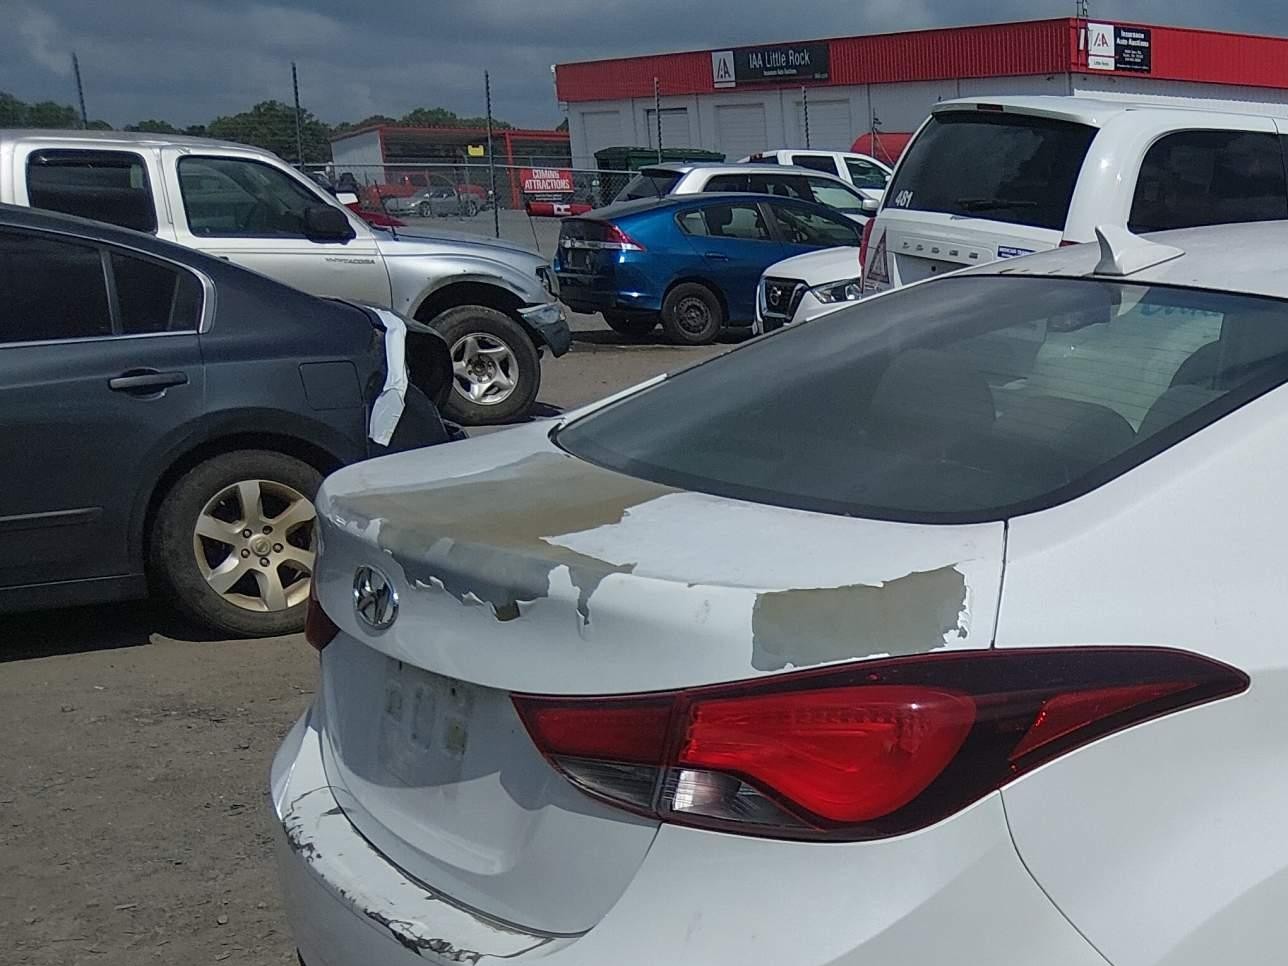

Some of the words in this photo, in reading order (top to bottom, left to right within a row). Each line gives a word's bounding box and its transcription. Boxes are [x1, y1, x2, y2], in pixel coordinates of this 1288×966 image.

[749, 52, 763, 69] IAA
[765, 51, 786, 68] Little
[788, 48, 811, 66] Rock
[532, 169, 560, 179] COMING
[524, 179, 570, 190] ATTRACTIONS
[895, 190, 914, 208] 481
